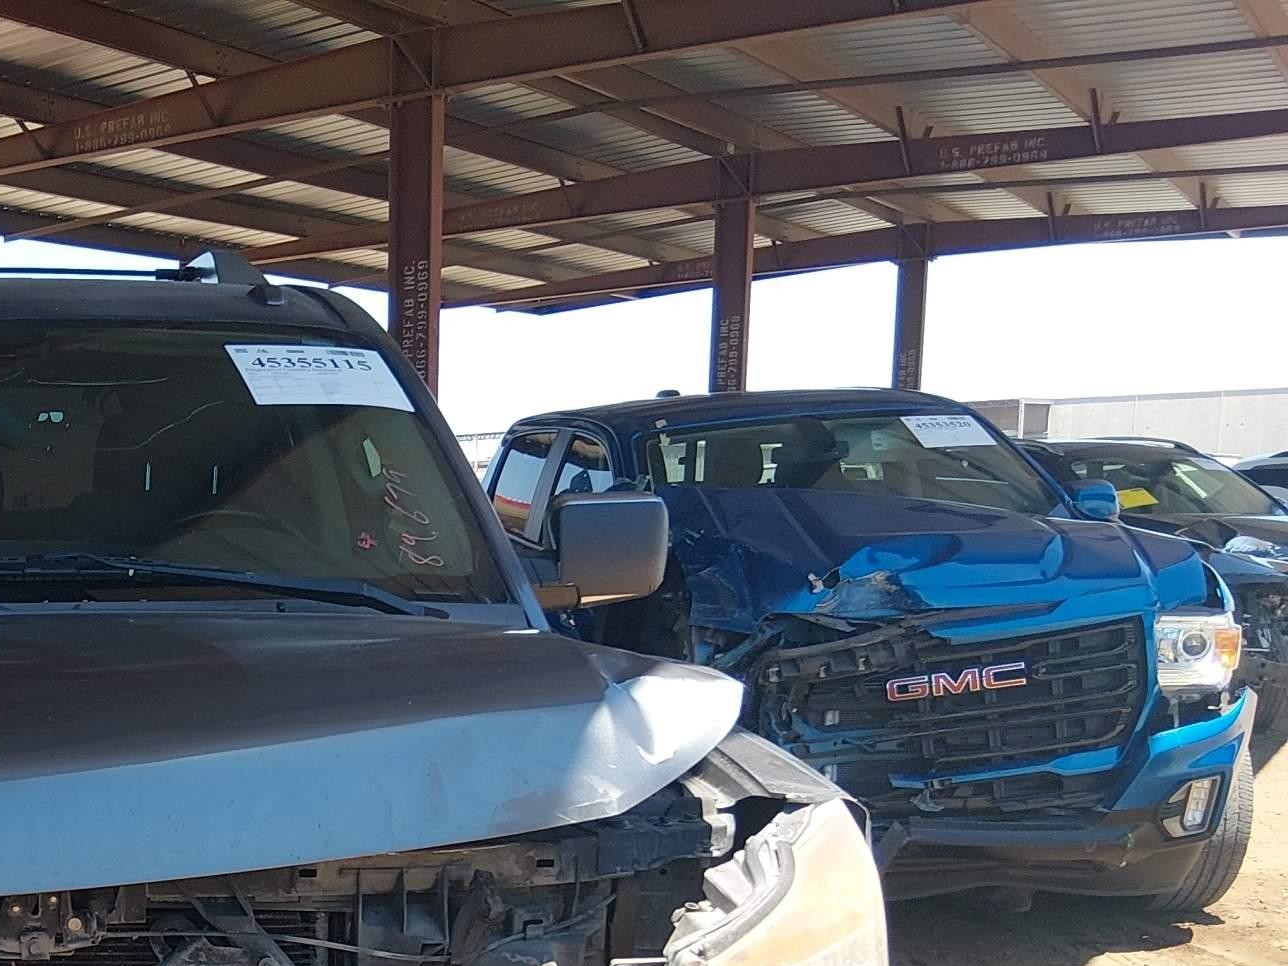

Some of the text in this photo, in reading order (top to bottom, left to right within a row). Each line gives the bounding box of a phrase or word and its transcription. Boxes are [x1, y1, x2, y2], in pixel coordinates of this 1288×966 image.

[401, 298, 415, 358] PREFAB
[251, 356, 373, 372] 45355115
[886, 662, 1027, 702] GMC
